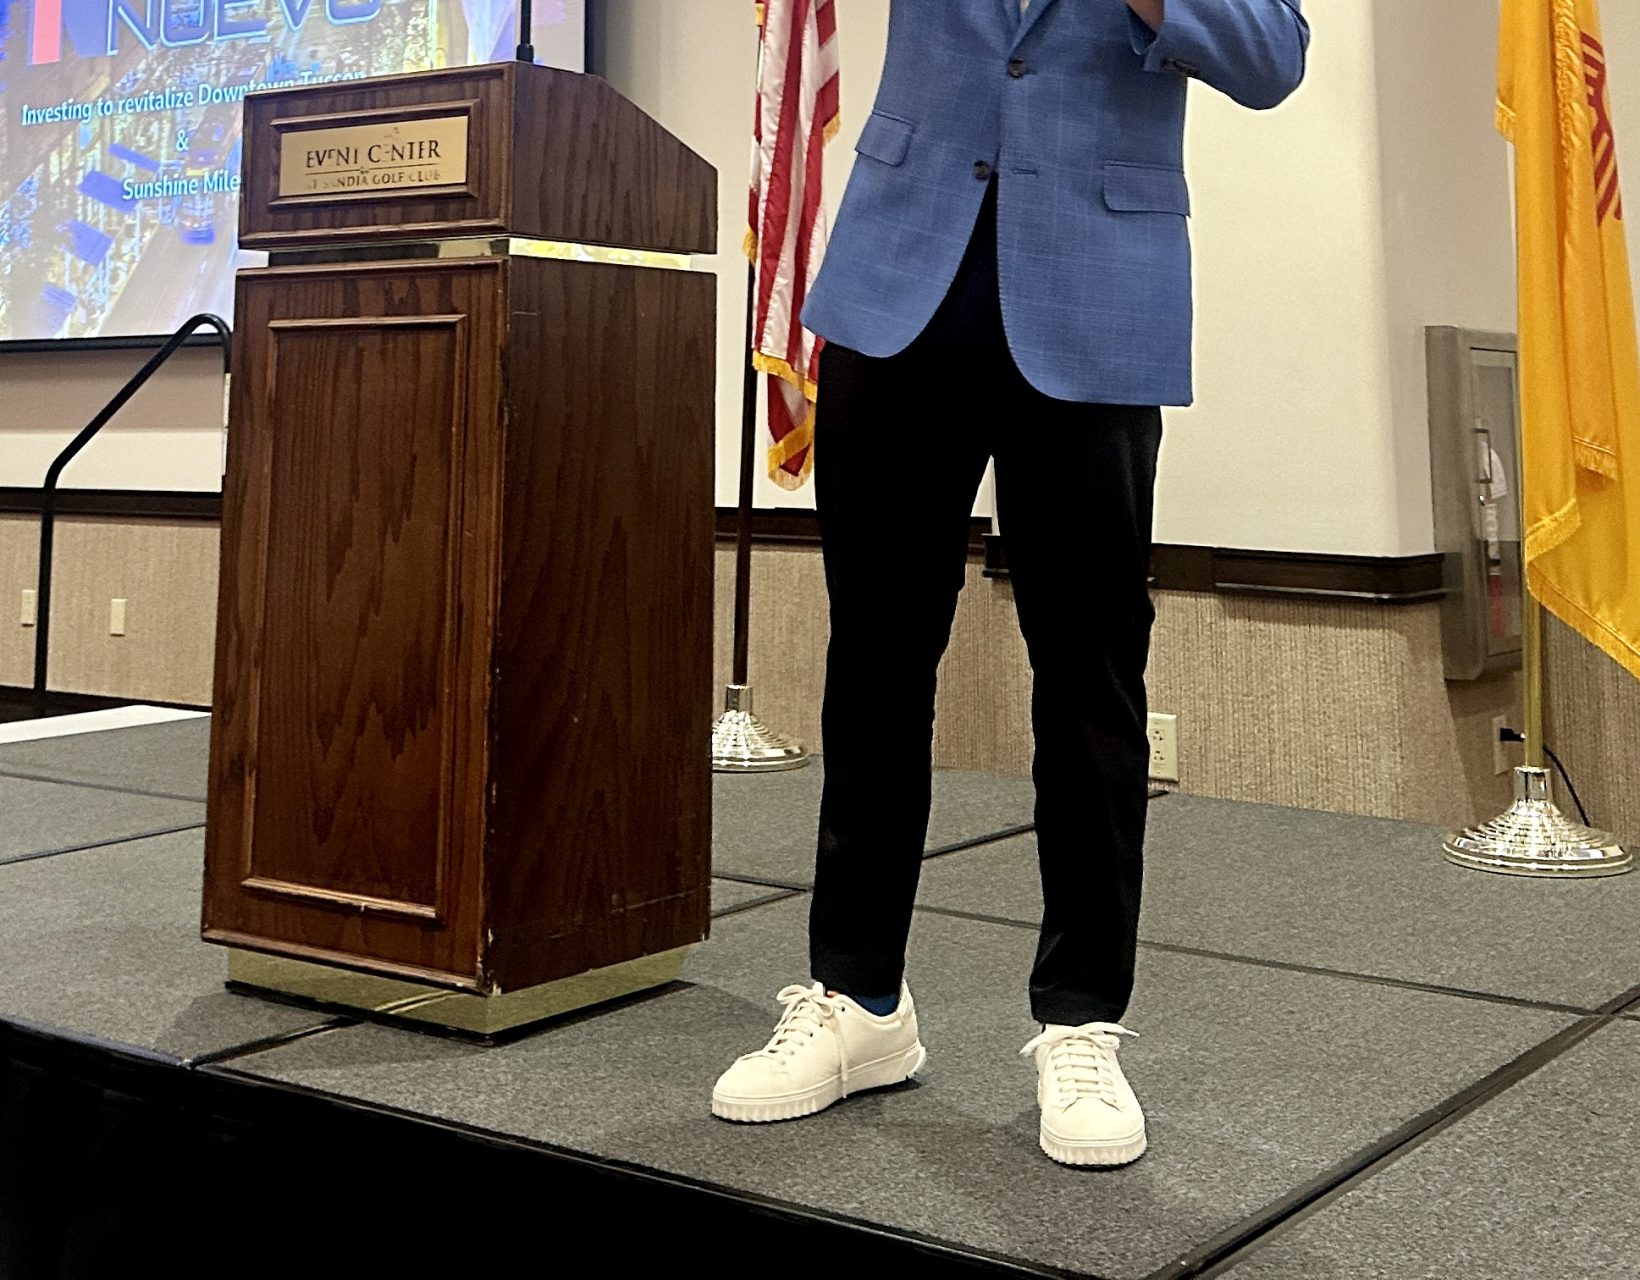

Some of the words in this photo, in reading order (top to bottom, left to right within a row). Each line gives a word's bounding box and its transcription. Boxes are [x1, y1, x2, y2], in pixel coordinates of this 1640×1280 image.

[22, 98, 92, 125] Investing
[97, 100, 114, 116] to
[118, 86, 194, 113] revitalize
[175, 130, 189, 151] &
[368, 139, 441, 163] CNTER
[122, 173, 198, 200] Sunshine
[203, 169, 241, 194] Mile
[372, 172, 404, 185] GOLF
